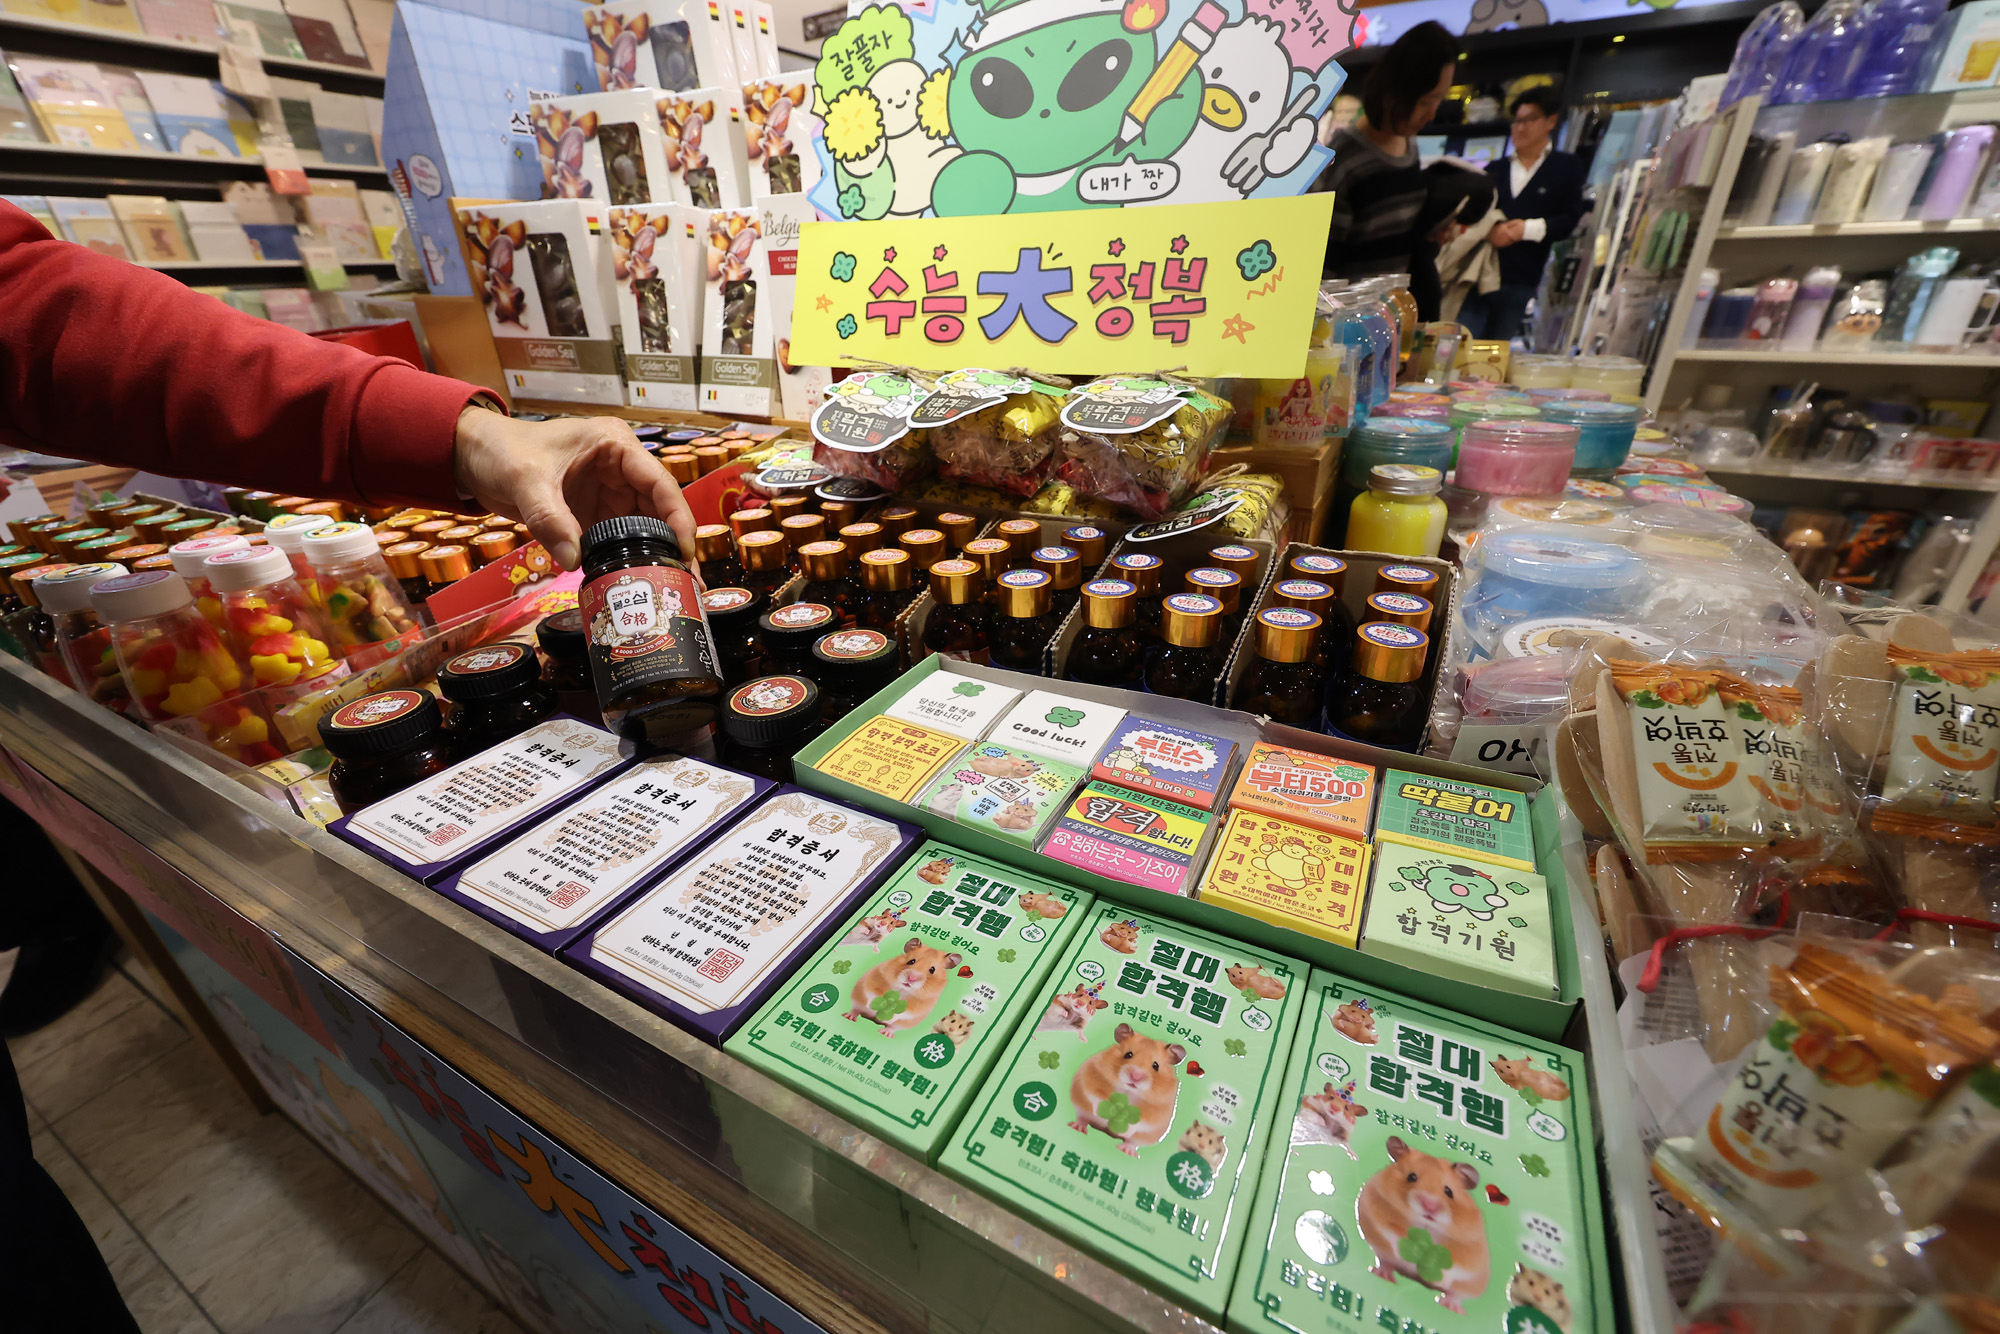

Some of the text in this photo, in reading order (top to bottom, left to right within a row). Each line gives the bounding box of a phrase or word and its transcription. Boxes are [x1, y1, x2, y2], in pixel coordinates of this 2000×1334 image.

[829, 29, 893, 80] 잘풀자
[1089, 167, 1163, 192] 내가 짱
[867, 247, 1207, 344] 수능 大 정복
[639, 360, 679, 372] Golden Sea
[715, 362, 756, 375] Golden Sea
[620, 611, 648, 627] 合格
[918, 697, 975, 717] 당신의 합격을
[918, 705, 966, 722] 기원합니다!
[867, 727, 939, 756] 합격 초코
[1012, 723, 1047, 737] Good
[1050, 732, 1085, 747] luck!
[1642, 715, 1729, 742] 호박엿
[1938, 720, 1983, 747] 전통
[525, 743, 579, 767] 합격증서
[1135, 736, 1202, 763] 부터스
[1671, 742, 1718, 764] 전통
[634, 783, 696, 810] 합격증서
[1124, 772, 1151, 785] 행운을
[1155, 781, 1181, 793] 빌어요
[1249, 761, 1362, 806] 부터500
[1094, 783, 1204, 818] 합격기원/만점신화
[1310, 808, 1339, 820] 500mg
[1399, 783, 1514, 822] 딱붙어
[1079, 794, 1192, 848] 합격 합니다!
[1415, 808, 1490, 830] 초강력 합격
[1454, 825, 1495, 840] 절대합격
[767, 828, 839, 861] 합격증서
[1070, 835, 1179, 881] 원하는곳-가즈아
[1219, 818, 1256, 884] 합격기원
[709, 862, 777, 893] 누구보다 뛰어난 실력을
[746, 854, 767, 865] 남다른
[766, 862, 789, 873] 노력과
[751, 845, 770, 855] 사람은
[797, 863, 826, 879] 공부하고,
[756, 869, 777, 880] 열정과
[699, 870, 797, 916] 매시간 노력과 최선을 다했습니다.
[956, 873, 1015, 905] 절대
[1327, 845, 1356, 917] 절대합격
[711, 915, 742, 931] 것이기에
[719, 904, 760, 925] 원하는 곳에
[728, 894, 744, 905] 높은
[744, 901, 767, 915] 점수를
[767, 912, 784, 922] 받아
[921, 891, 1010, 936] 합격햄
[641, 934, 677, 954] 원하는 곳에
[684, 916, 713, 933] 합격증을
[713, 929, 750, 951] 수여합니다.
[909, 922, 979, 955] 합격길만 걸어요
[1397, 914, 1514, 960] 합격기원
[1151, 940, 1219, 982] 절대
[1118, 962, 1225, 1022] 합격햄
[808, 988, 946, 1063] 合 格
[1114, 1002, 1201, 1046] 합격길만 걸어요
[774, 1010, 937, 1098] 합격햄! 축하햄! 행복햄!
[1398, 1026, 1479, 1080] 절대
[1370, 1057, 1503, 1132] 합격햄
[1023, 1090, 1205, 1190] 合 格
[1375, 1108, 1492, 1165] 합격길만 걸어요
[991, 1117, 1054, 1160] 합격햄!
[1061, 1151, 1127, 1198] 축하햄!
